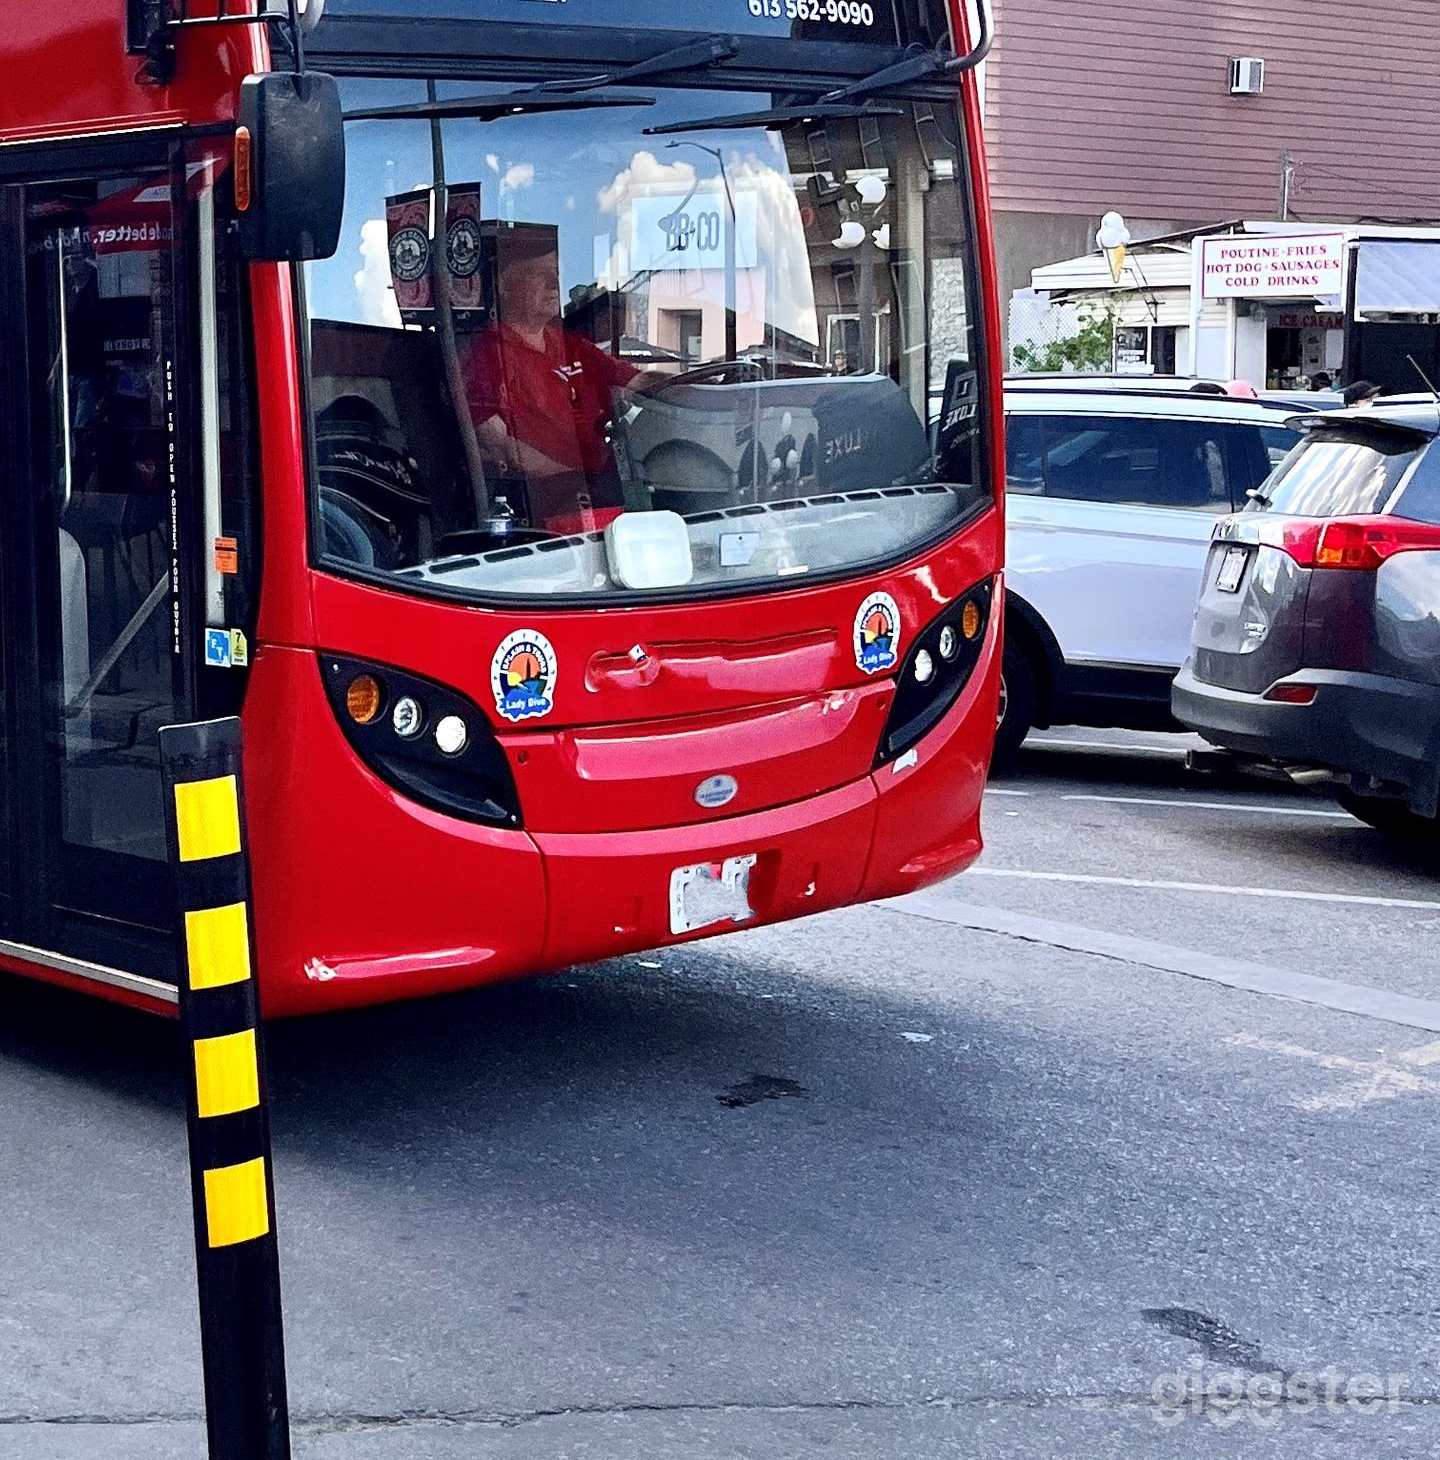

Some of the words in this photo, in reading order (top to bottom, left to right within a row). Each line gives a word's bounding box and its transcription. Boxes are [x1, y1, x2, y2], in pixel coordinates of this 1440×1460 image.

[1221, 246, 1280, 259] POUTINE
[1286, 244, 1327, 257] FRIES
[1206, 263, 1232, 274] HOT
[1235, 262, 1262, 274] DOG
[1271, 259, 1340, 272] SAUSAGES
[1225, 277, 1259, 287] COLD
[1267, 275, 1319, 286] DRINKS
[1278, 314, 1298, 327] ICE
[505, 700, 526, 710] Lady
